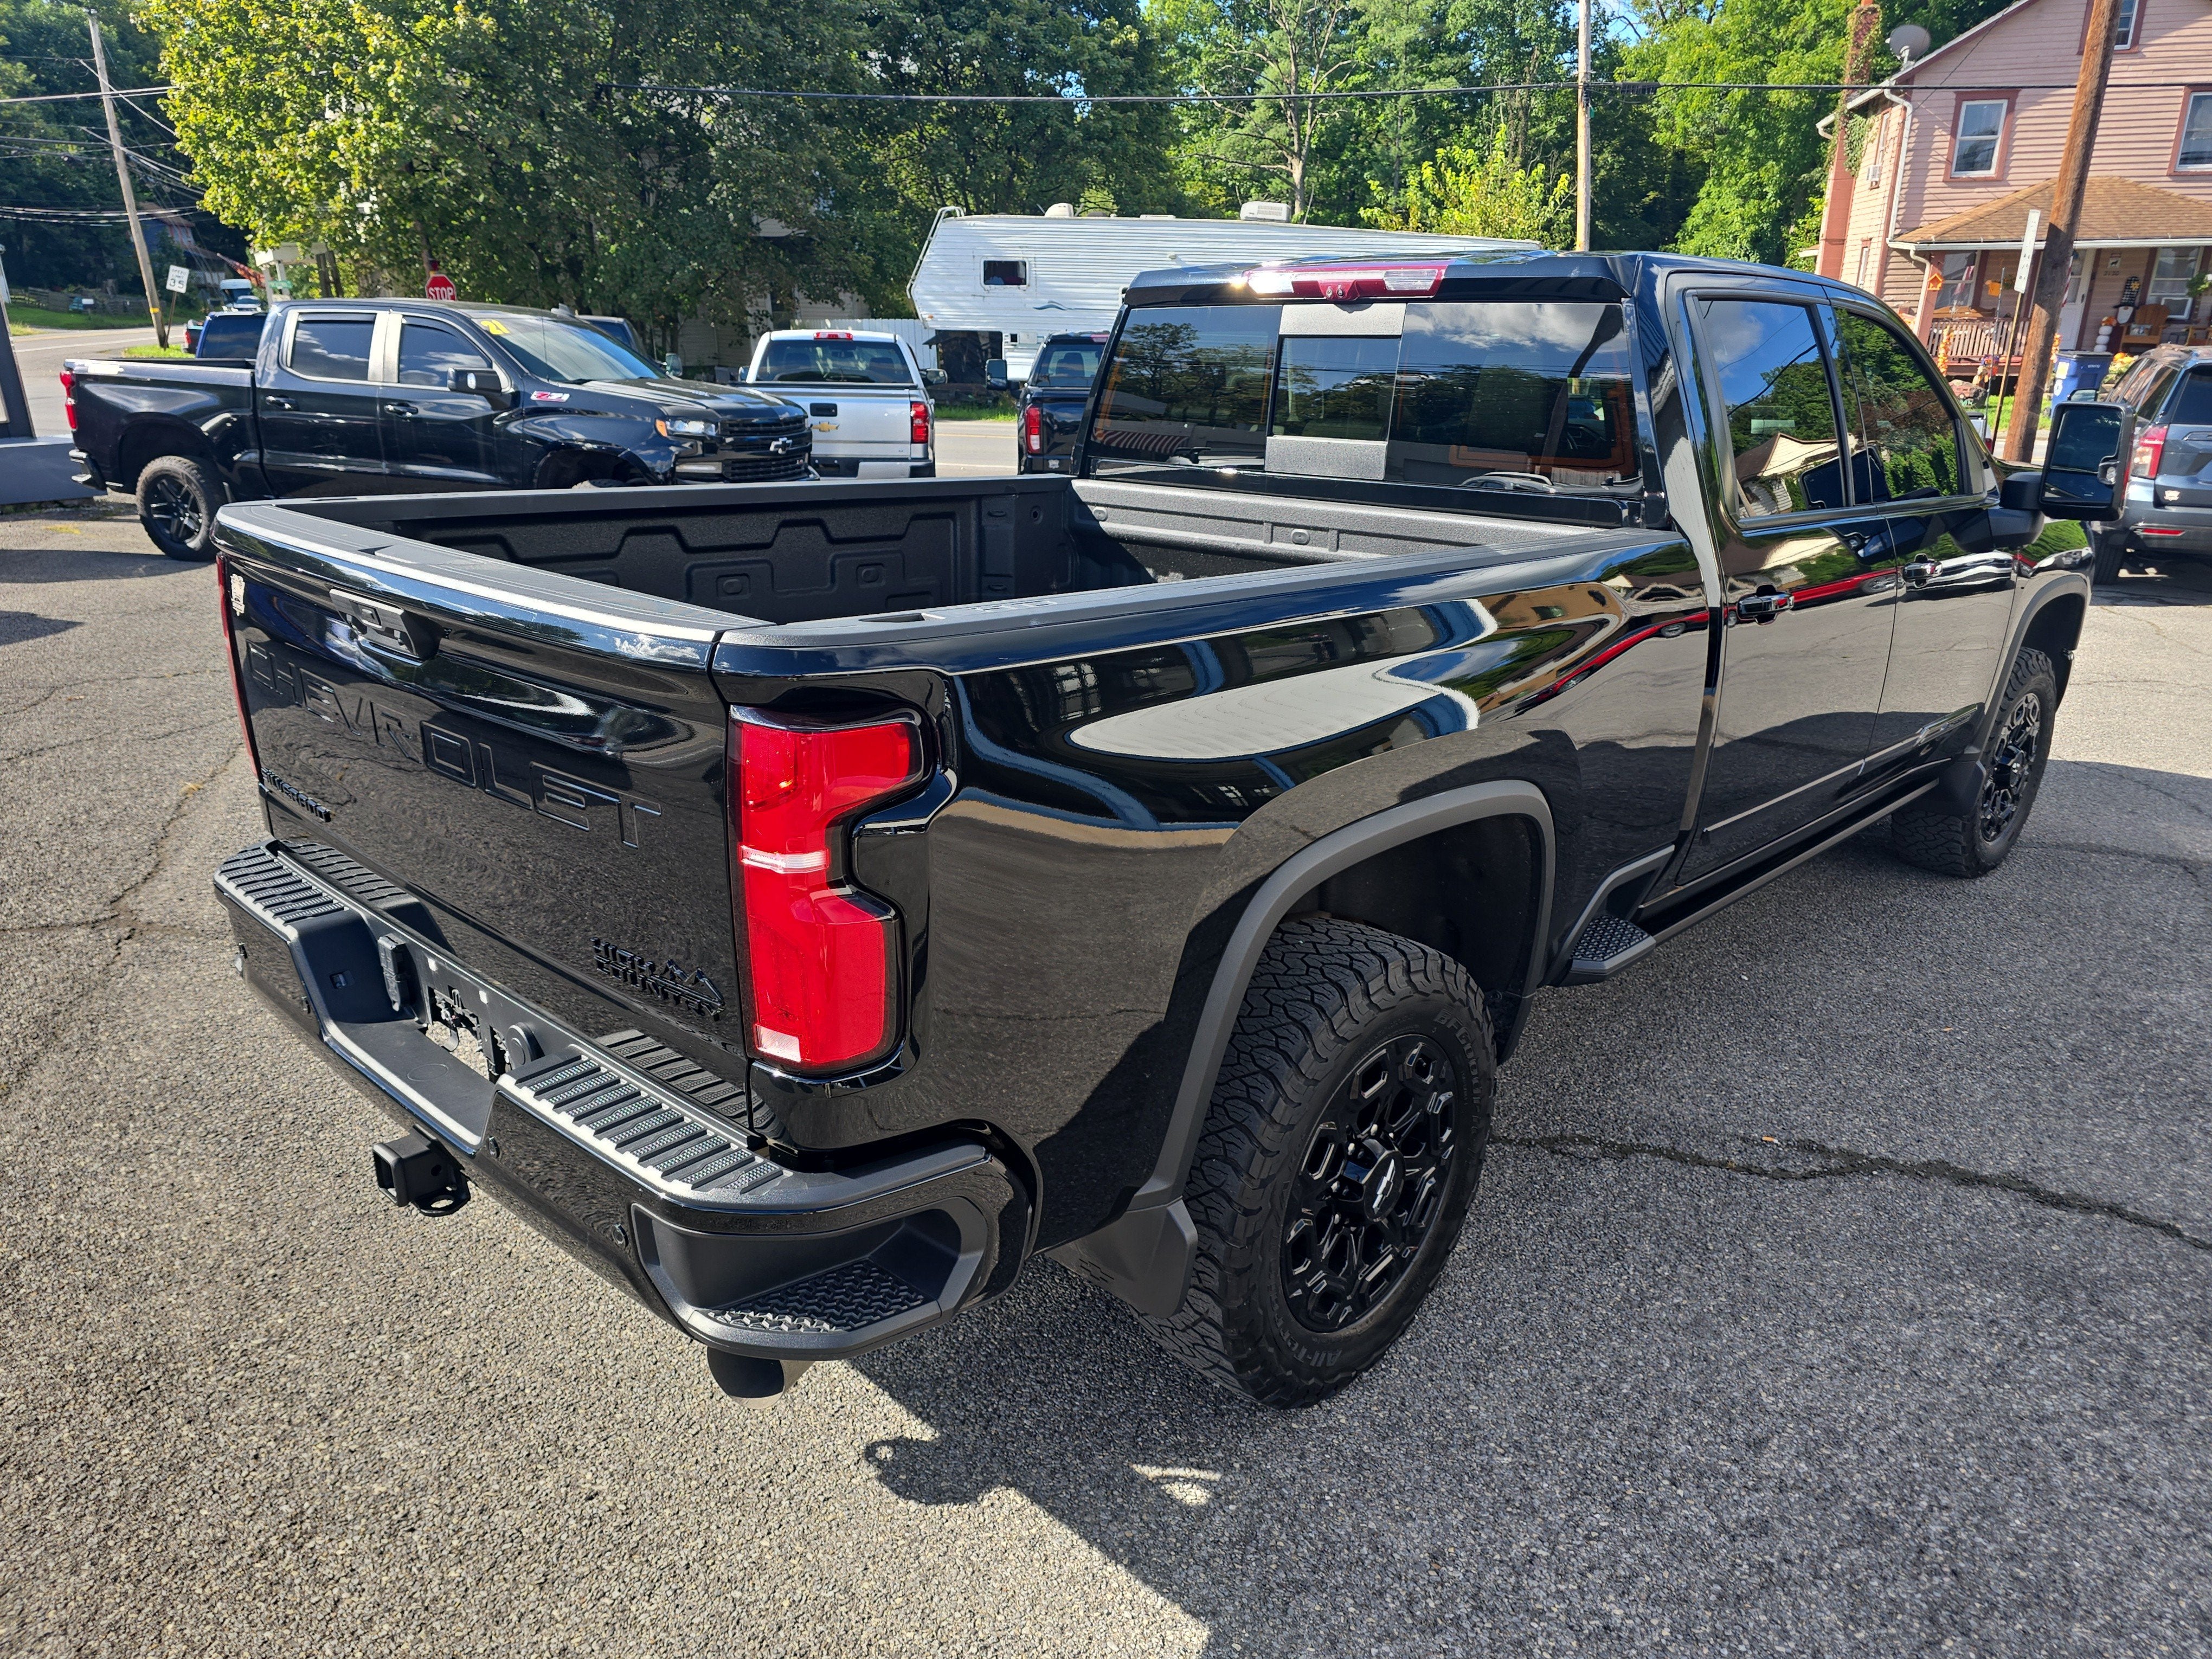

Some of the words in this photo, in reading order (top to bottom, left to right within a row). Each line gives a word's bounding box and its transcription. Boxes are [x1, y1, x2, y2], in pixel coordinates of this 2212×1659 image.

[169, 278, 184, 288] 35
[428, 286, 454, 301] STOP
[480, 320, 510, 335] 21
[530, 390, 570, 402] Z71
[245, 638, 663, 851] CHEVROLET
[260, 767, 331, 822] SILVERADO
